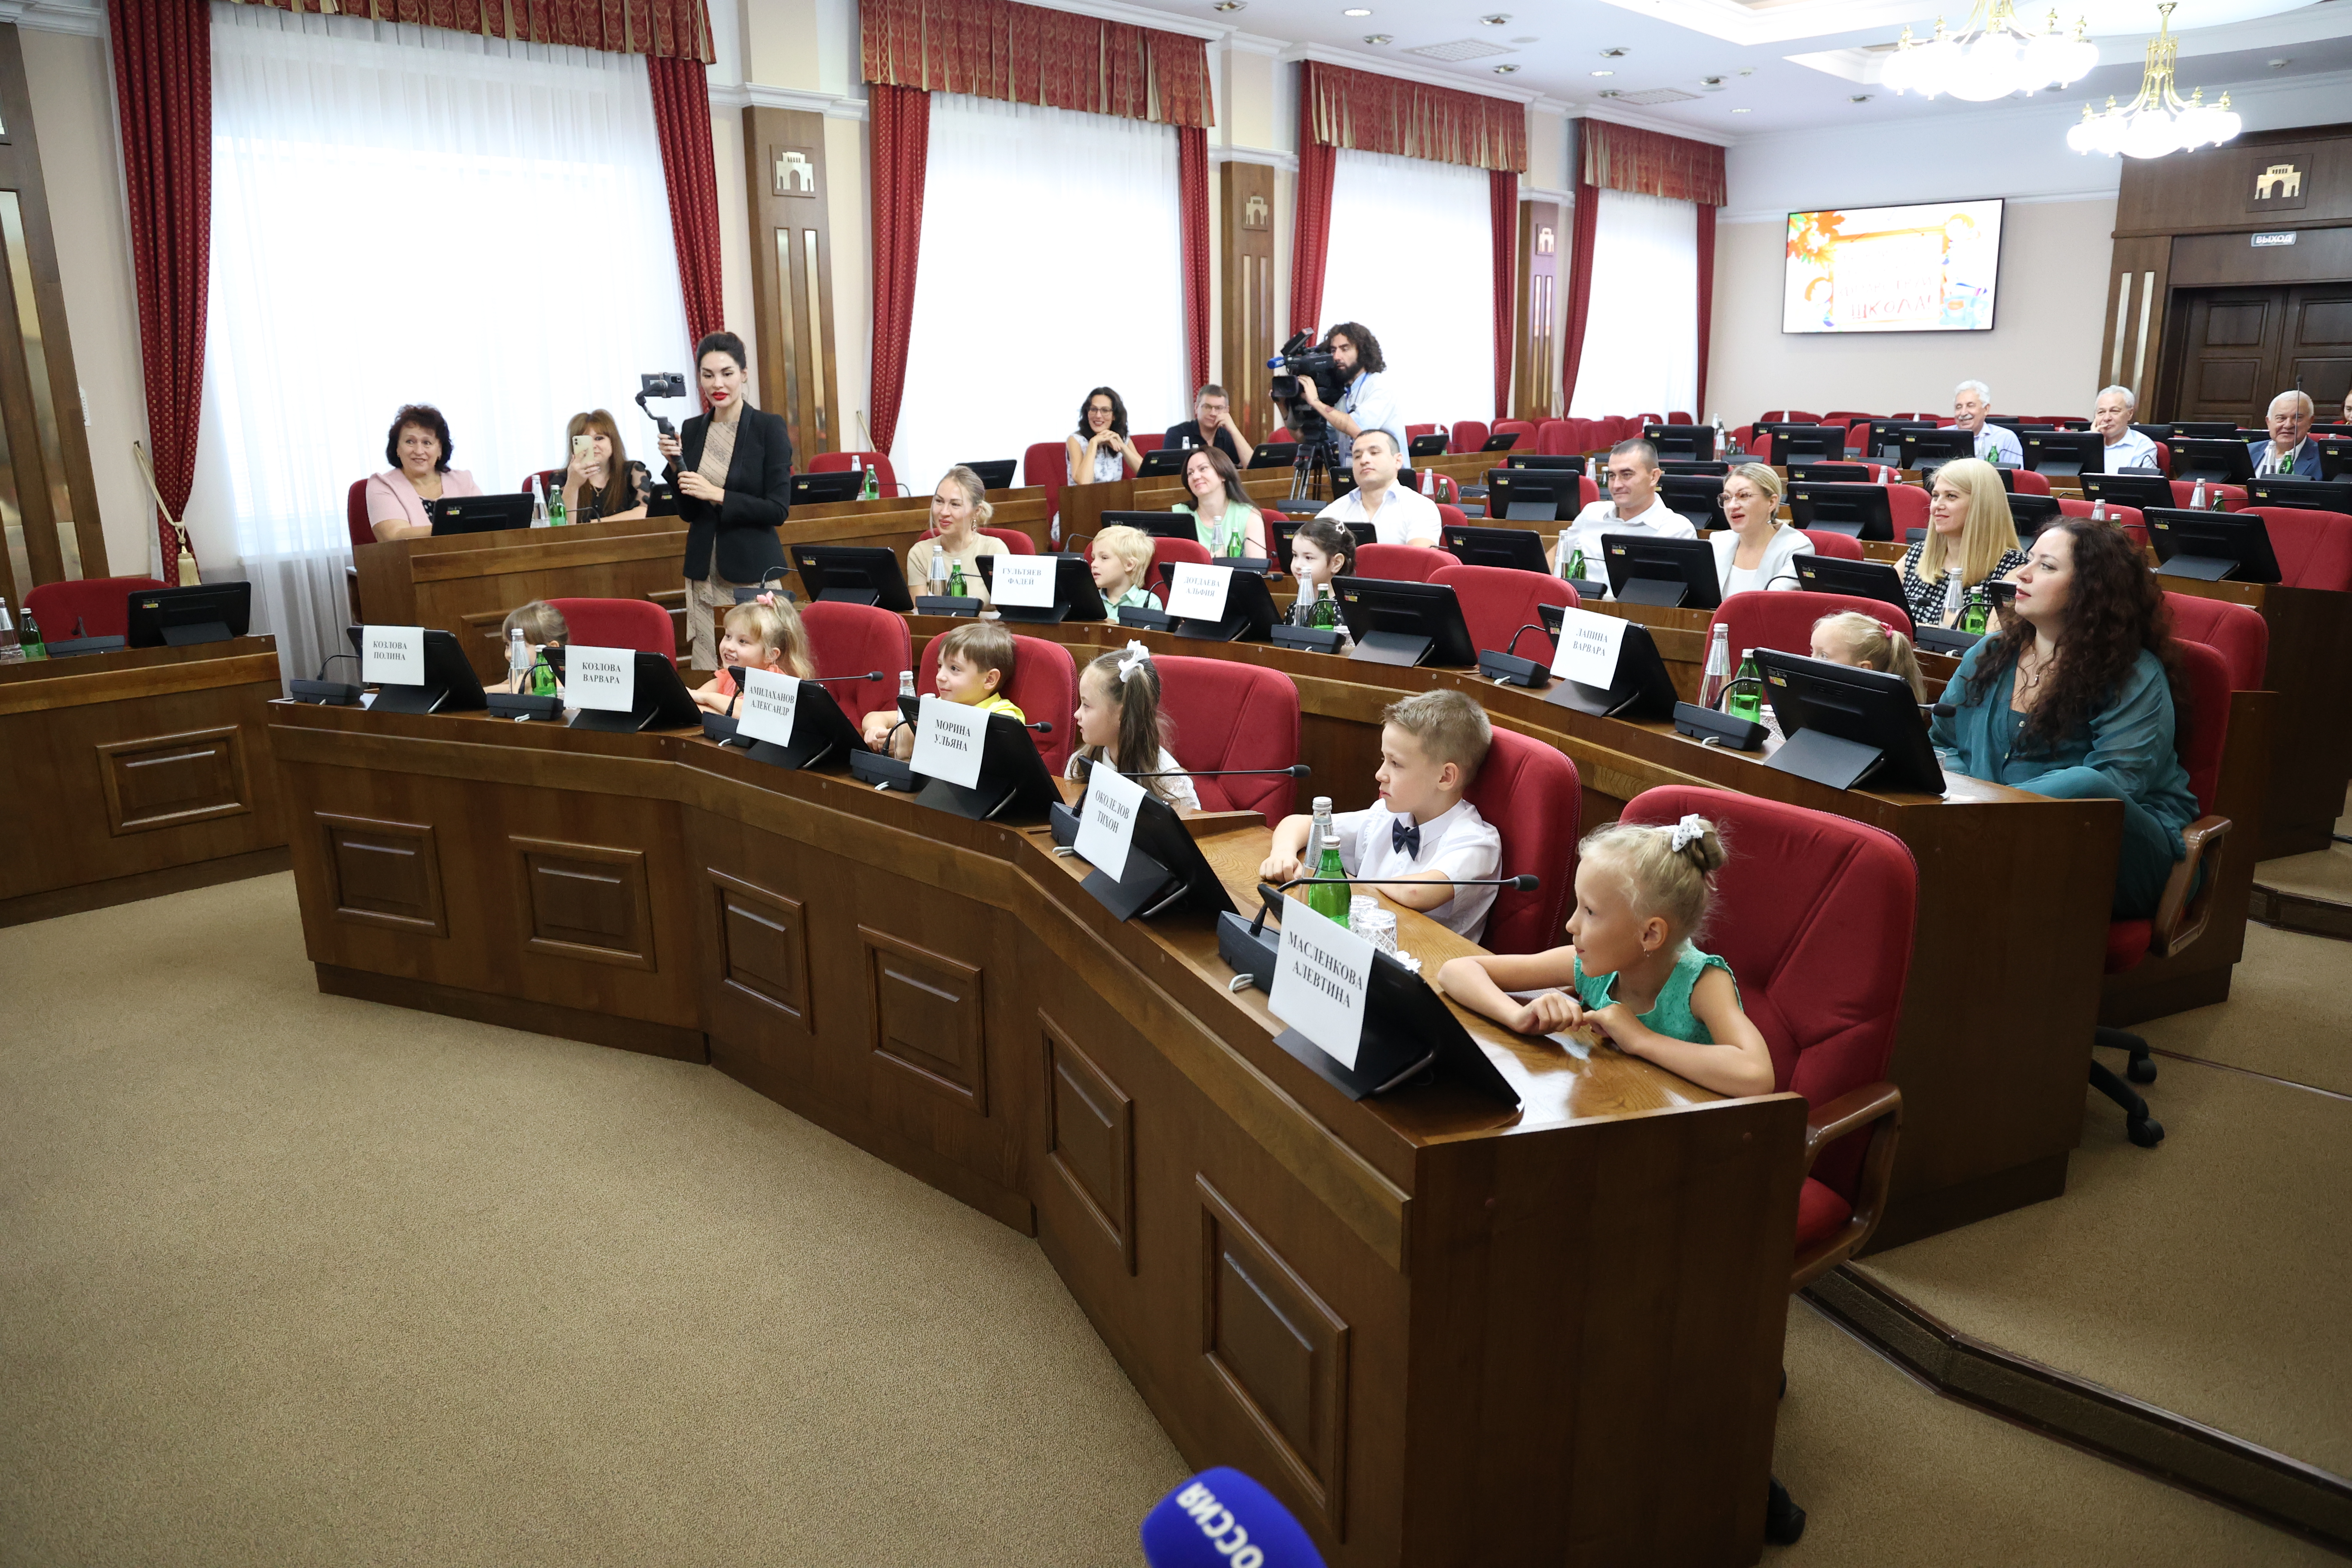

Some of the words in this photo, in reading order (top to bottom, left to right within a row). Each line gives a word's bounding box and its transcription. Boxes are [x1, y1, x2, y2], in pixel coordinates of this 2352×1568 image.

[2256, 234, 2294, 243] ВЫХОД
[1852, 295, 1930, 319] ШКОЛА!
[1008, 577, 1034, 585] ФАДЕЙ
[1184, 576, 1219, 587] ДОТДАЕВА
[1186, 587, 1215, 597] АЛЬФИЯ
[1576, 628, 1607, 643] ЛАПИНА
[373, 641, 407, 649] КОЗЛОВА
[1573, 641, 1605, 656] ВАРВАРА
[374, 652, 406, 660] ПОЛИНА
[582, 662, 621, 672] КОЗЛОВА
[583, 674, 620, 684] ВАРВАРА
[749, 685, 794, 704] АМИЛАХАНОВ
[750, 699, 789, 716] АЛЕКСАНДР
[935, 719, 970, 737] МОРИНА
[934, 734, 967, 751] УЛЬЯНА
[1096, 790, 1130, 819] ОКОЛЕЛОВ
[1097, 810, 1119, 833] ТИХОН
[1288, 931, 1363, 991] МАСЛЕНКОВА
[1292, 960, 1350, 1008] АЛЕВТИНА
[1175, 1481, 1264, 1568] ОССИЯ
